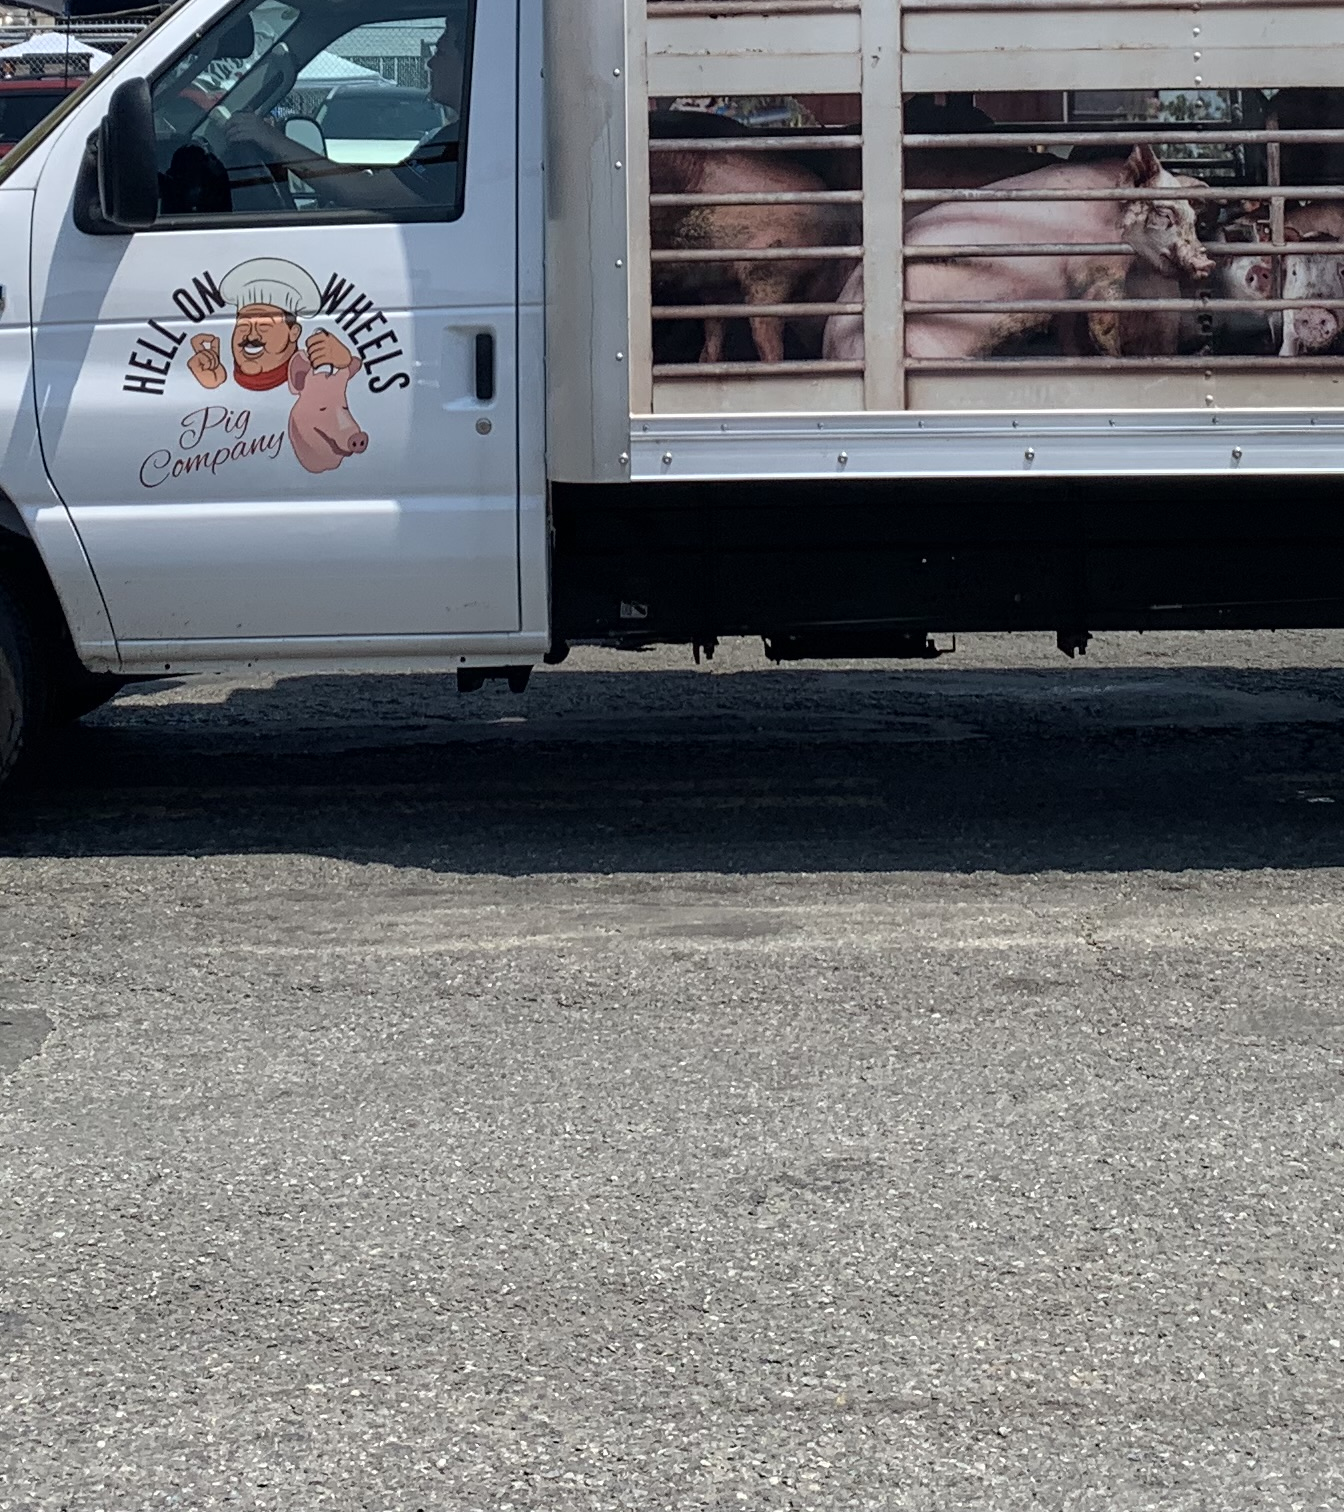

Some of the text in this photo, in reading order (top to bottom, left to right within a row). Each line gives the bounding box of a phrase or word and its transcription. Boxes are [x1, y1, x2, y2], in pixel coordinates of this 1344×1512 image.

[123, 271, 410, 395] HELL ON WHEELS
[179, 406, 250, 450] Pig
[139, 430, 285, 488] Company
